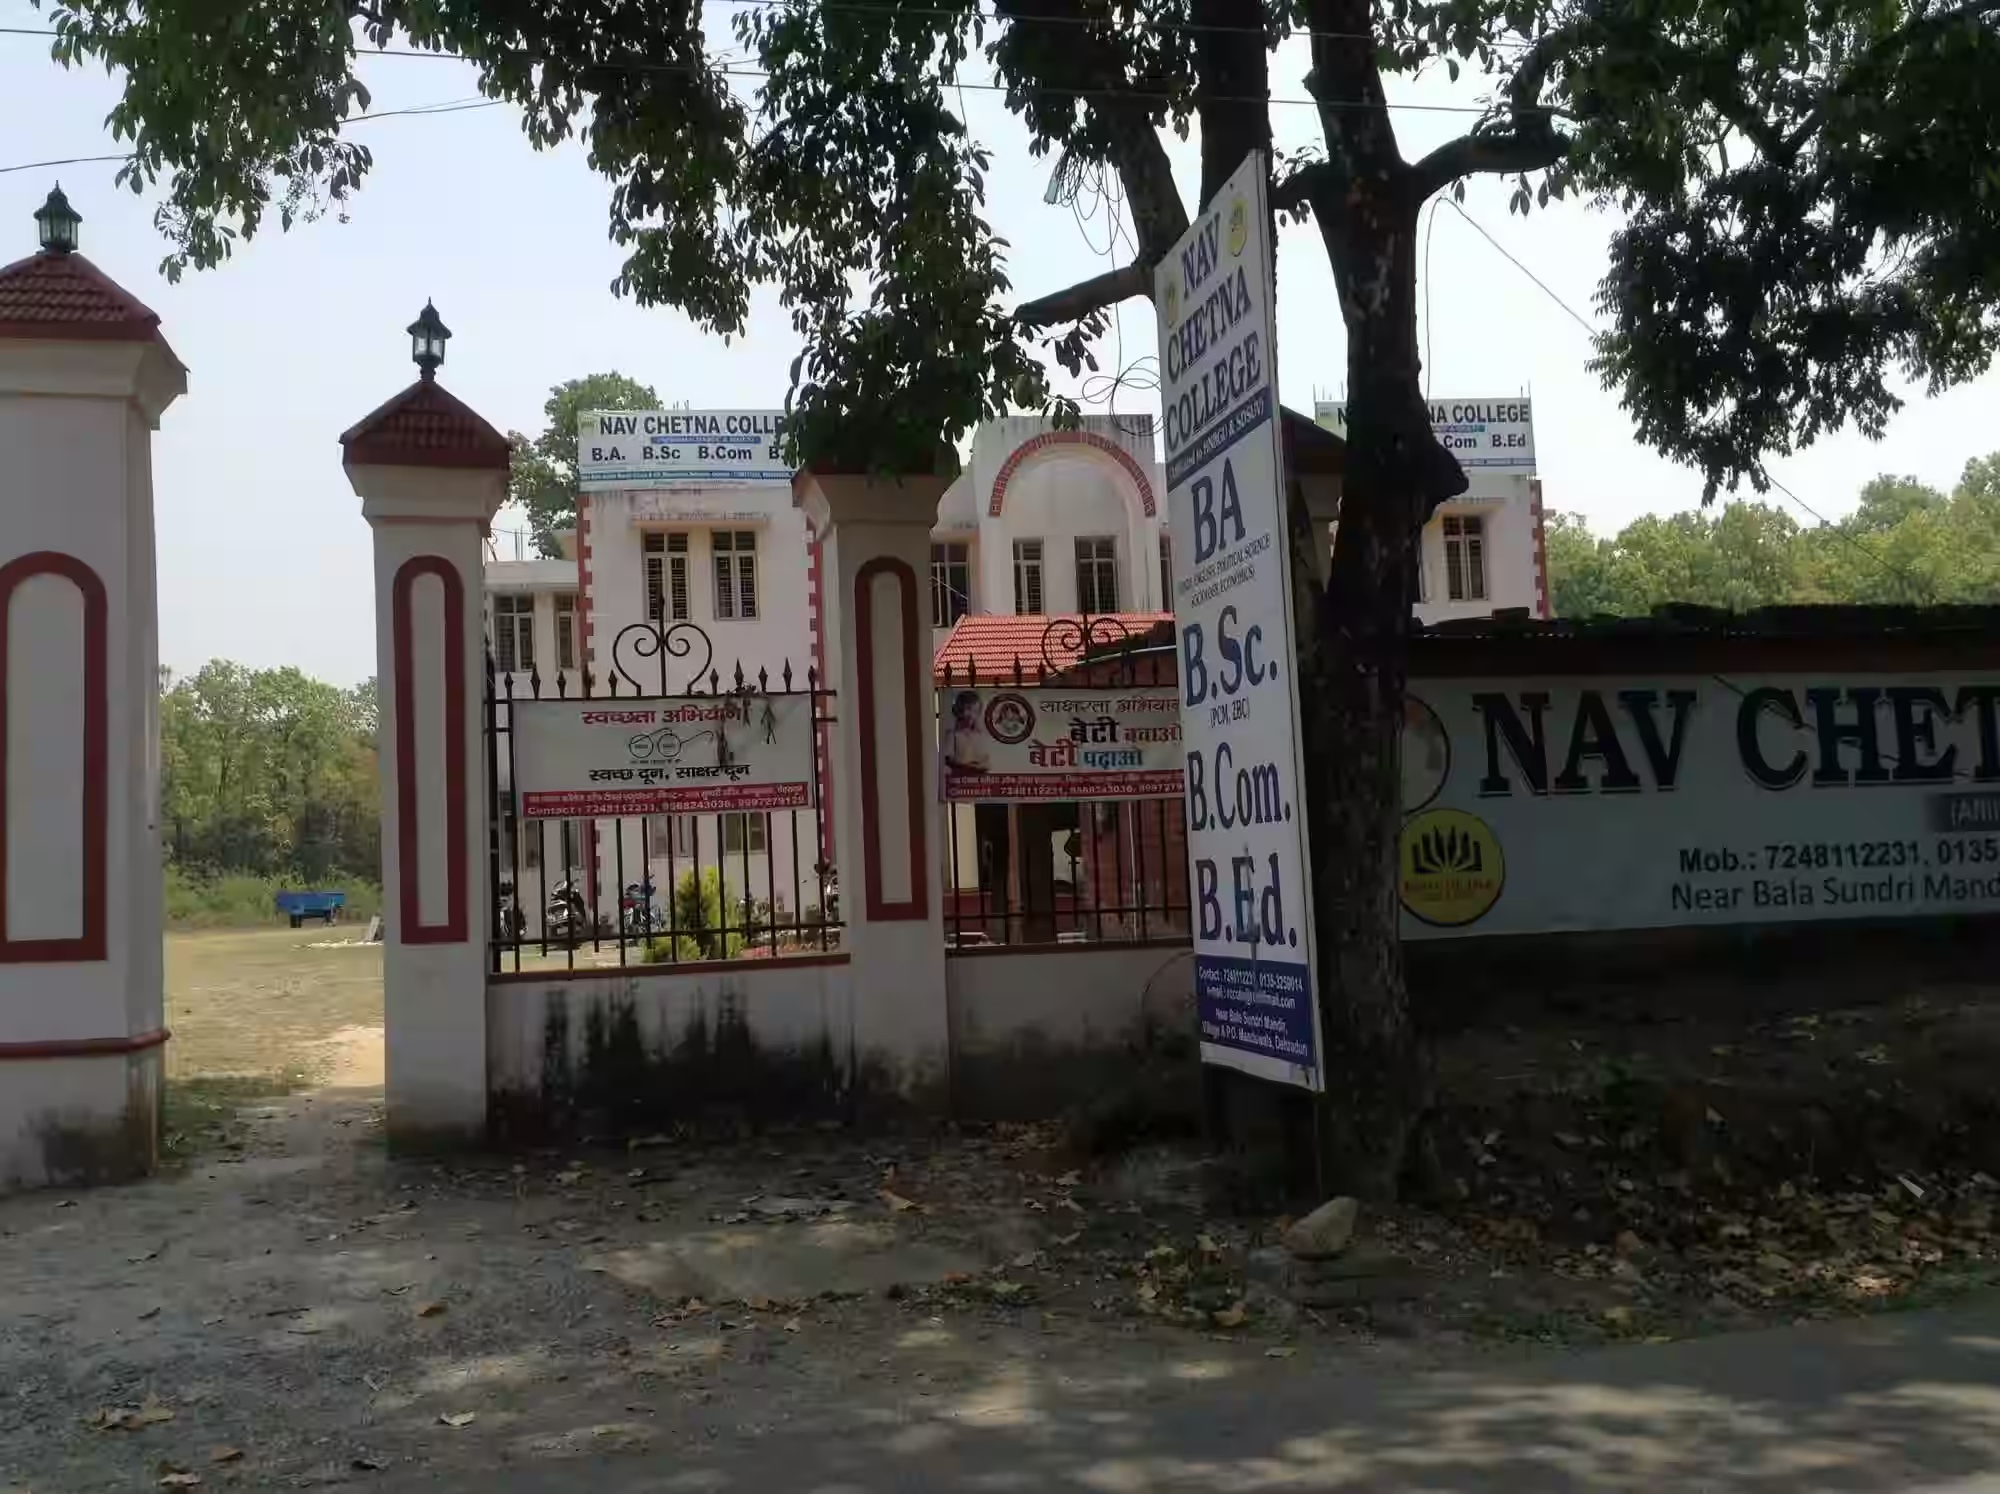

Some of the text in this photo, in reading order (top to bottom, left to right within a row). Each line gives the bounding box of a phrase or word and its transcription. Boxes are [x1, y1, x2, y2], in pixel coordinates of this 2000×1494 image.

[1181, 212, 1221, 299] NAV
[1167, 265, 1251, 384] CHETNA
[599, 416, 637, 435] NAV
[644, 416, 720, 434] CHETNA
[1166, 331, 1261, 452] COLLEGE
[1452, 404, 1530, 423] COLLEGE
[591, 447, 626, 462] B.A.
[643, 446, 681, 460] B.Sc
[698, 446, 752, 460] B.Com
[1492, 434, 1526, 448] B.Ed
[1191, 457, 1246, 564] BA
[1182, 604, 1279, 707] B.Sc.
[1187, 742, 1291, 831] B.Com.
[1472, 688, 1700, 797] NAV
[1195, 851, 1297, 948] B.Ed.
[1671, 881, 1744, 912] Near
[1753, 876, 1814, 908] Bala
[1823, 873, 1914, 904] Sundri
